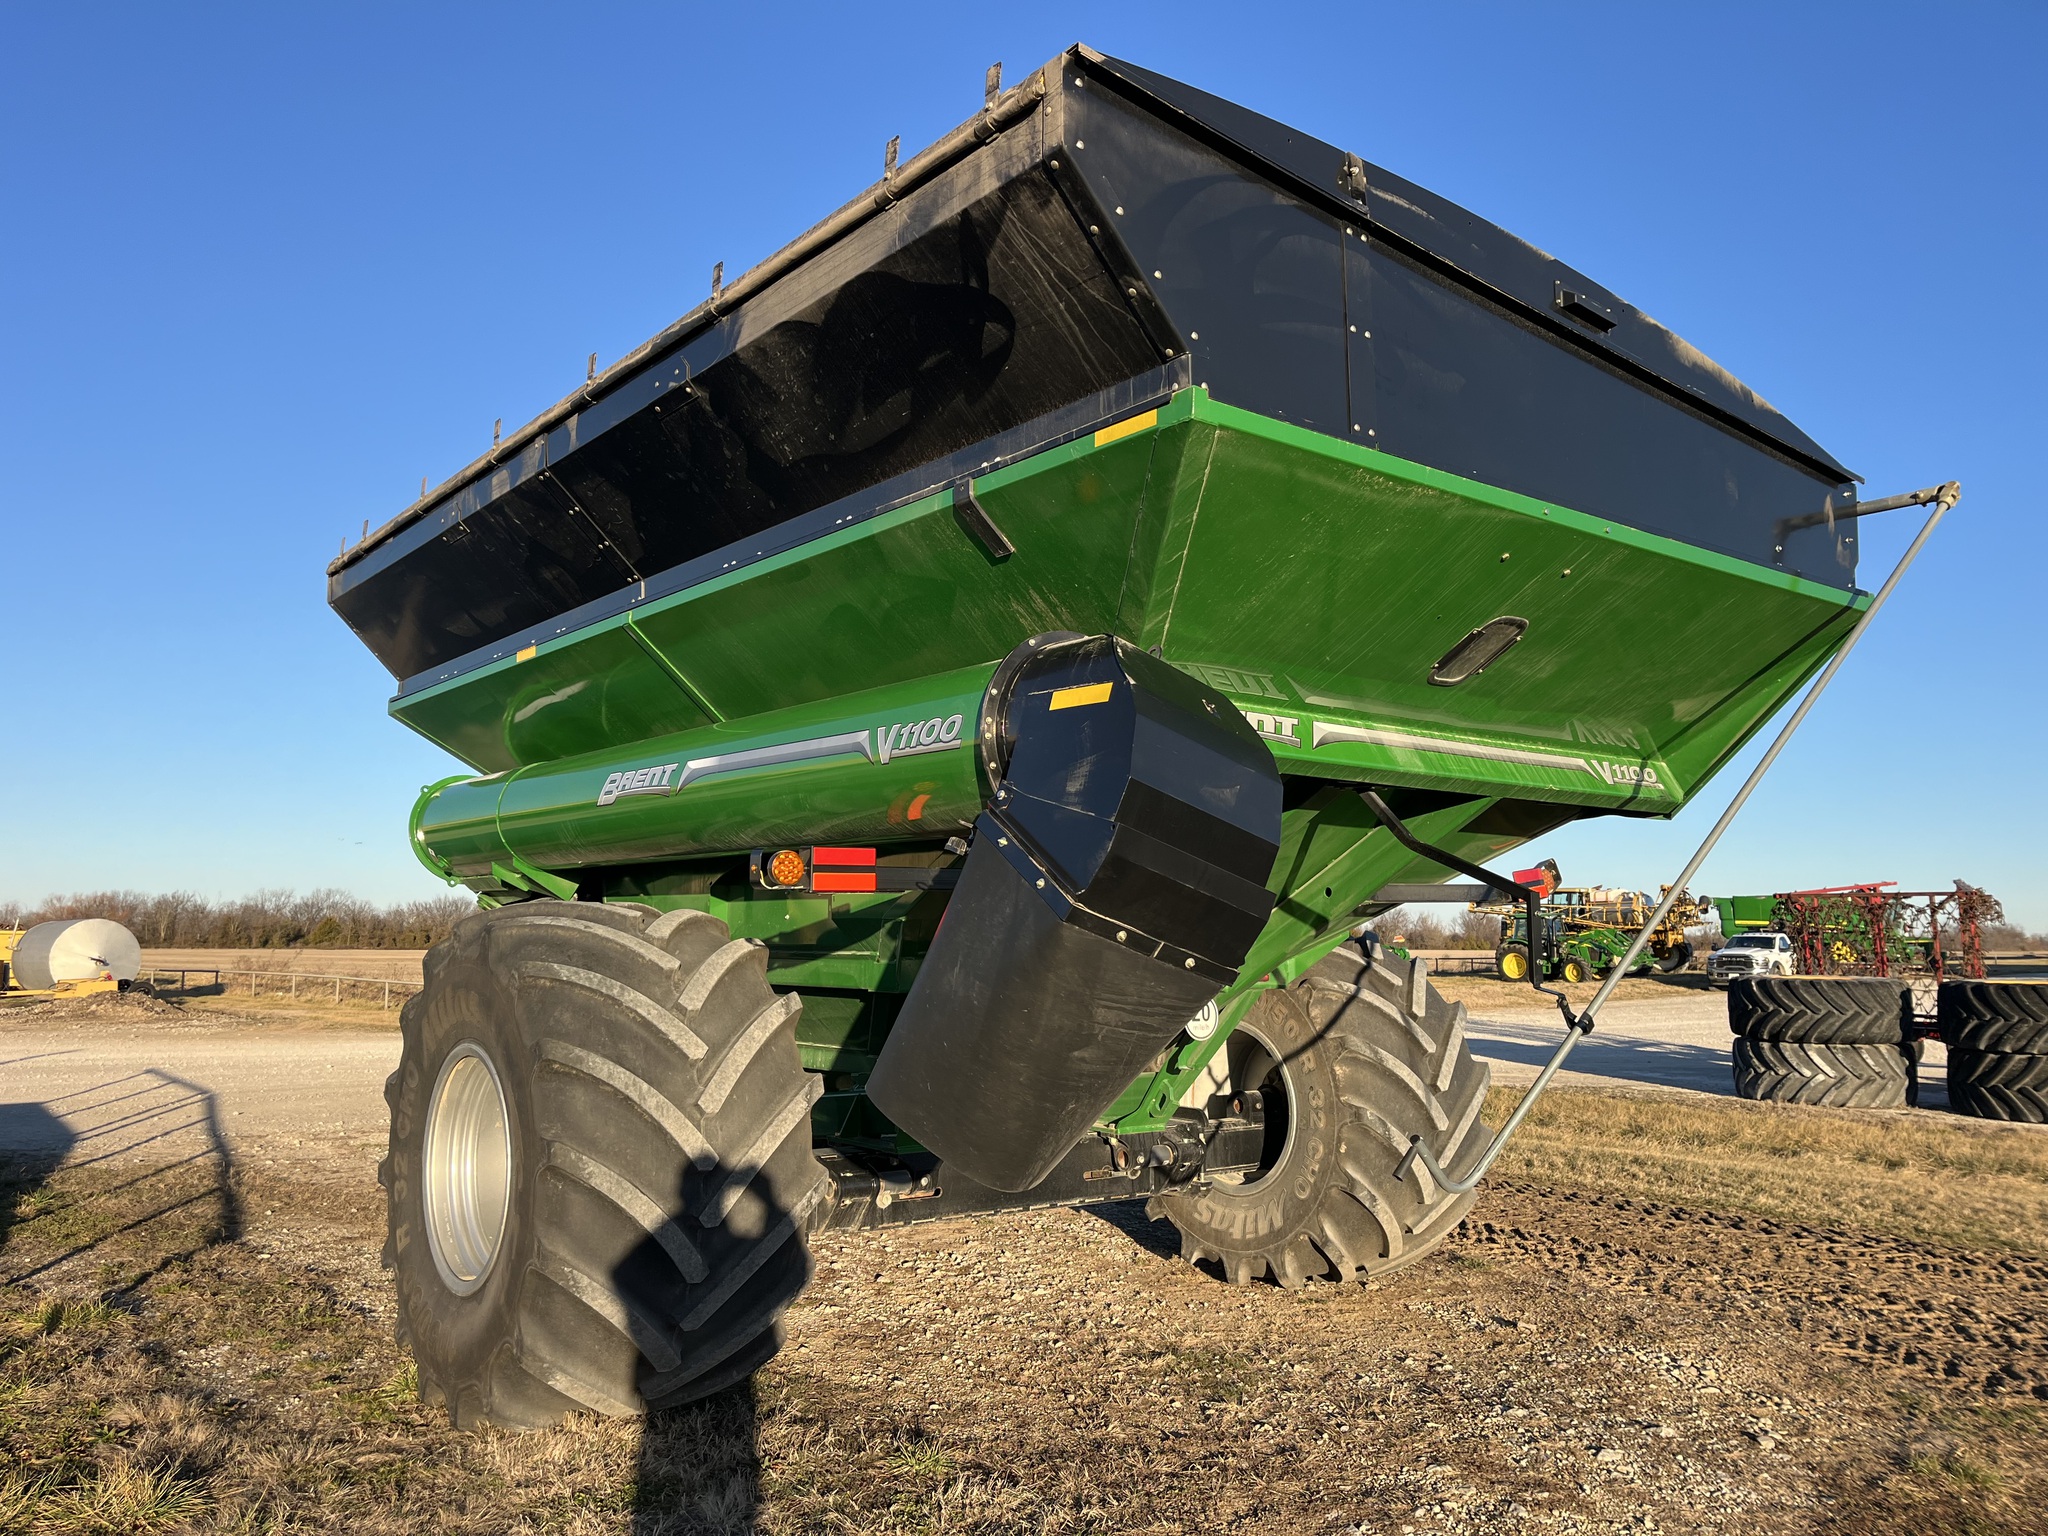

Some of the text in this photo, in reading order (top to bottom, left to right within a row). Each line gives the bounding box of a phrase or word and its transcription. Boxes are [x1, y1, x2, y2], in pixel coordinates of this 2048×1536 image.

[597, 714, 963, 806] BRENT V1100
[1591, 760, 1658, 786] V1100
[1298, 1049, 1316, 1074] R
[1308, 1088, 1327, 1130] 32
[1193, 1188, 1287, 1240] Mitas
